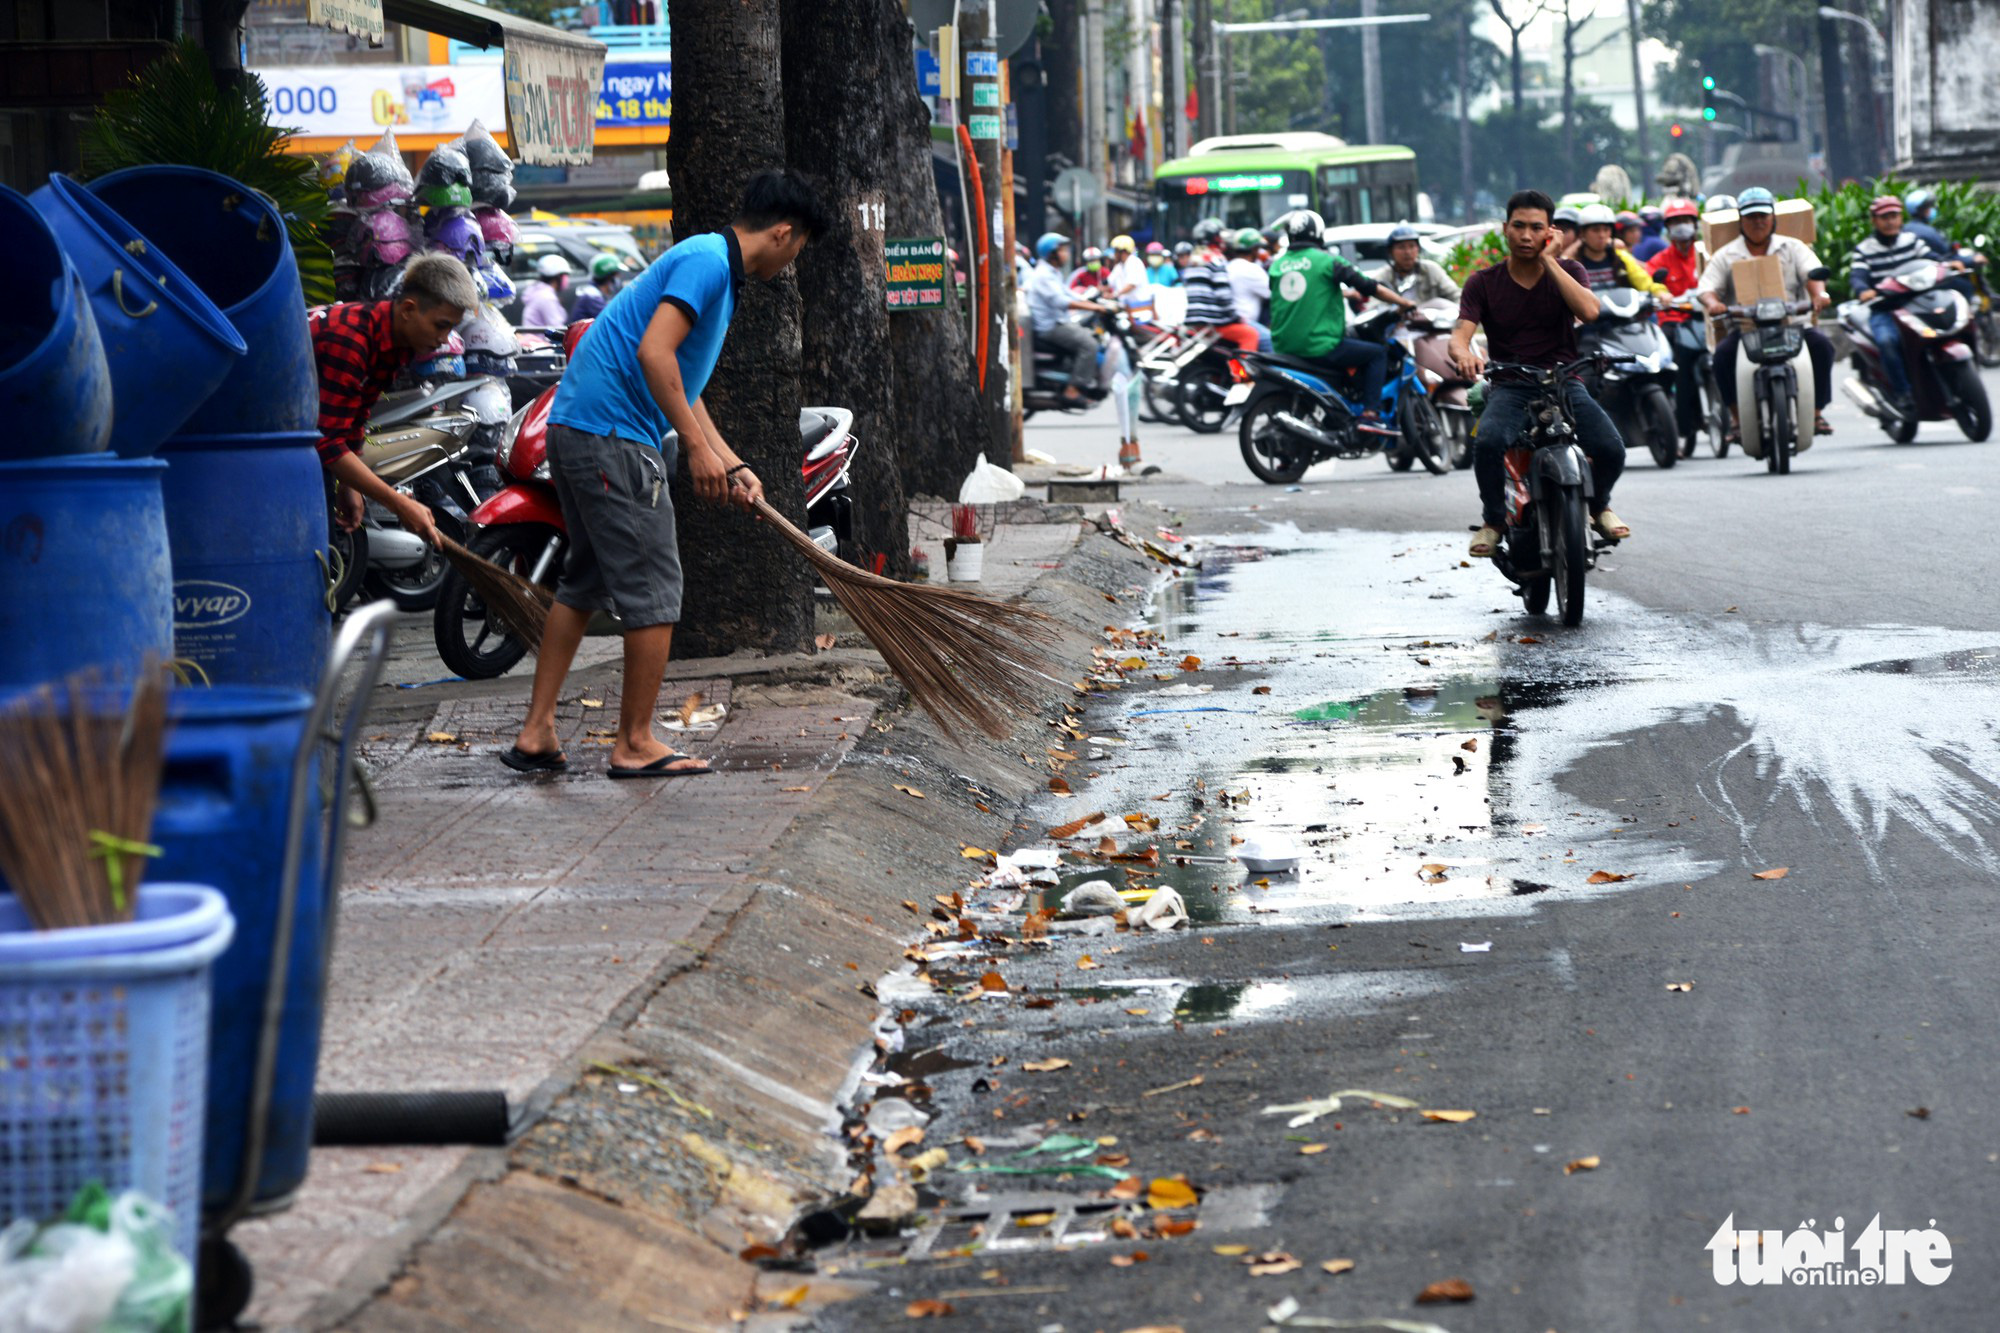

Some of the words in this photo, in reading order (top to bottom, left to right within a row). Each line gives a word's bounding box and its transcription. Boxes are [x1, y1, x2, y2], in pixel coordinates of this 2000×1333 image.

[607, 76, 655, 98] ngay
[616, 98, 640, 119] 18
[1280, 256, 1312, 272] Grab
[173, 593, 240, 617] vyap
